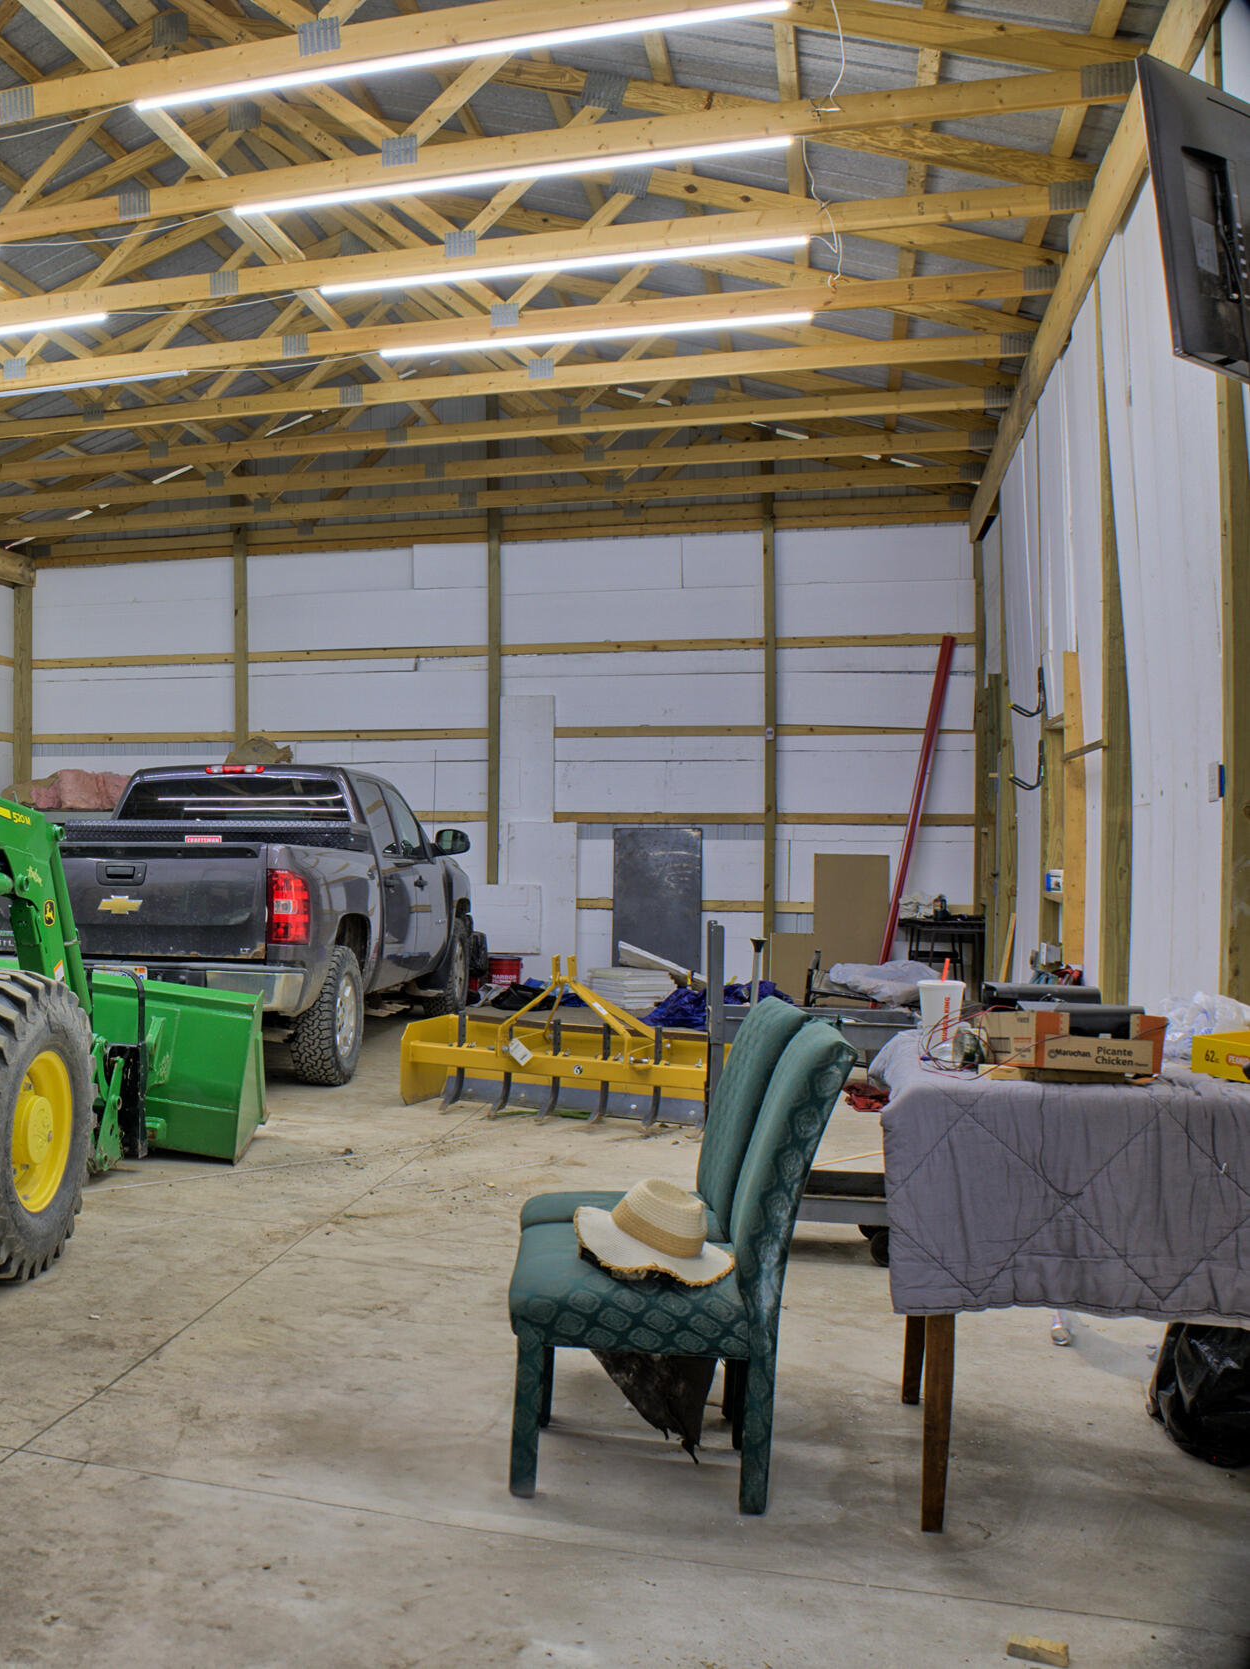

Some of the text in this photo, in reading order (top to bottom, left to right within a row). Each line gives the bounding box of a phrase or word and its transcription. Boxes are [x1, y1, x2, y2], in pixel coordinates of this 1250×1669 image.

[1055, 1048, 1091, 1058] Maruchan
[1097, 1046, 1133, 1057] Picante
[1095, 1056, 1134, 1067] Chicken
